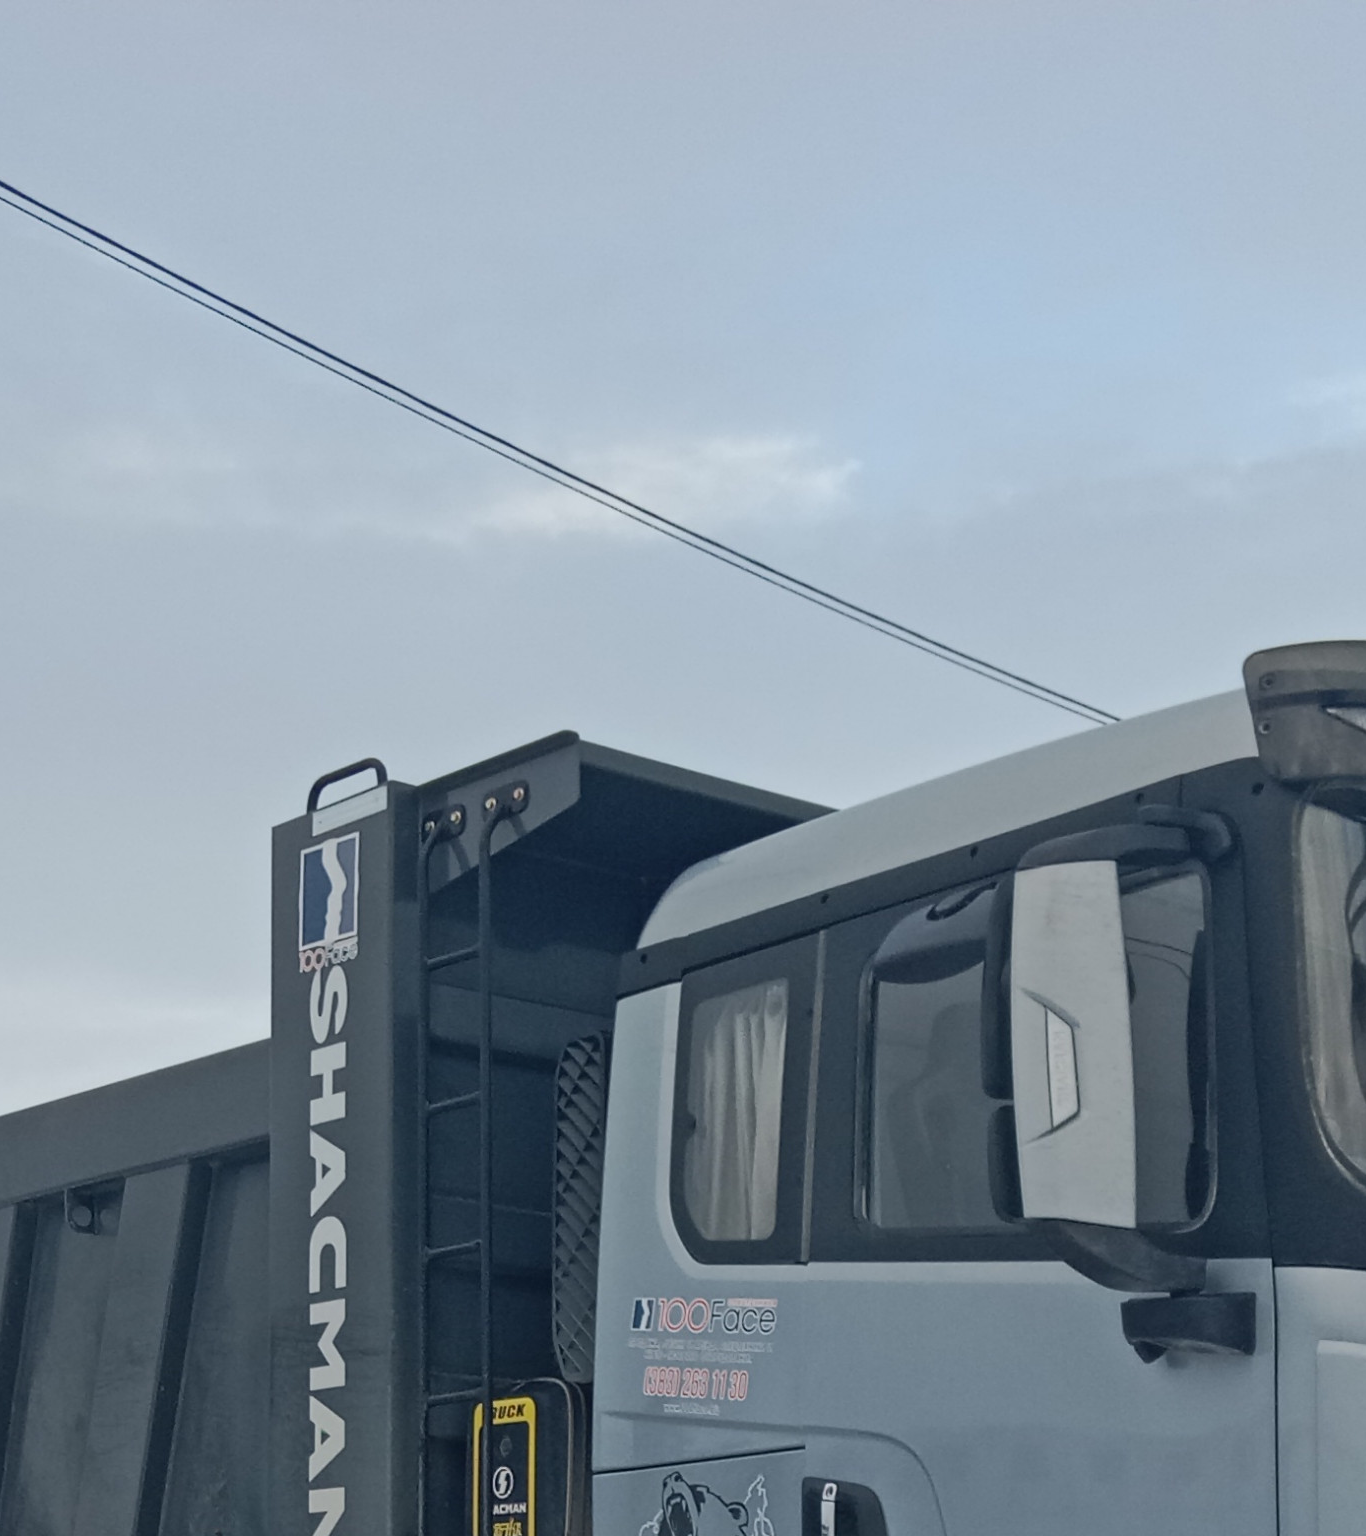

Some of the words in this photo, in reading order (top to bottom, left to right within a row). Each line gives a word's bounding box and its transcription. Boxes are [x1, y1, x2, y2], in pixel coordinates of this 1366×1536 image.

[657, 1298, 777, 1335] 100Face
[643, 1366, 681, 1397] (383)
[681, 1367, 709, 1399] 263
[711, 1369, 728, 1400] 11
[728, 1370, 749, 1401] 30
